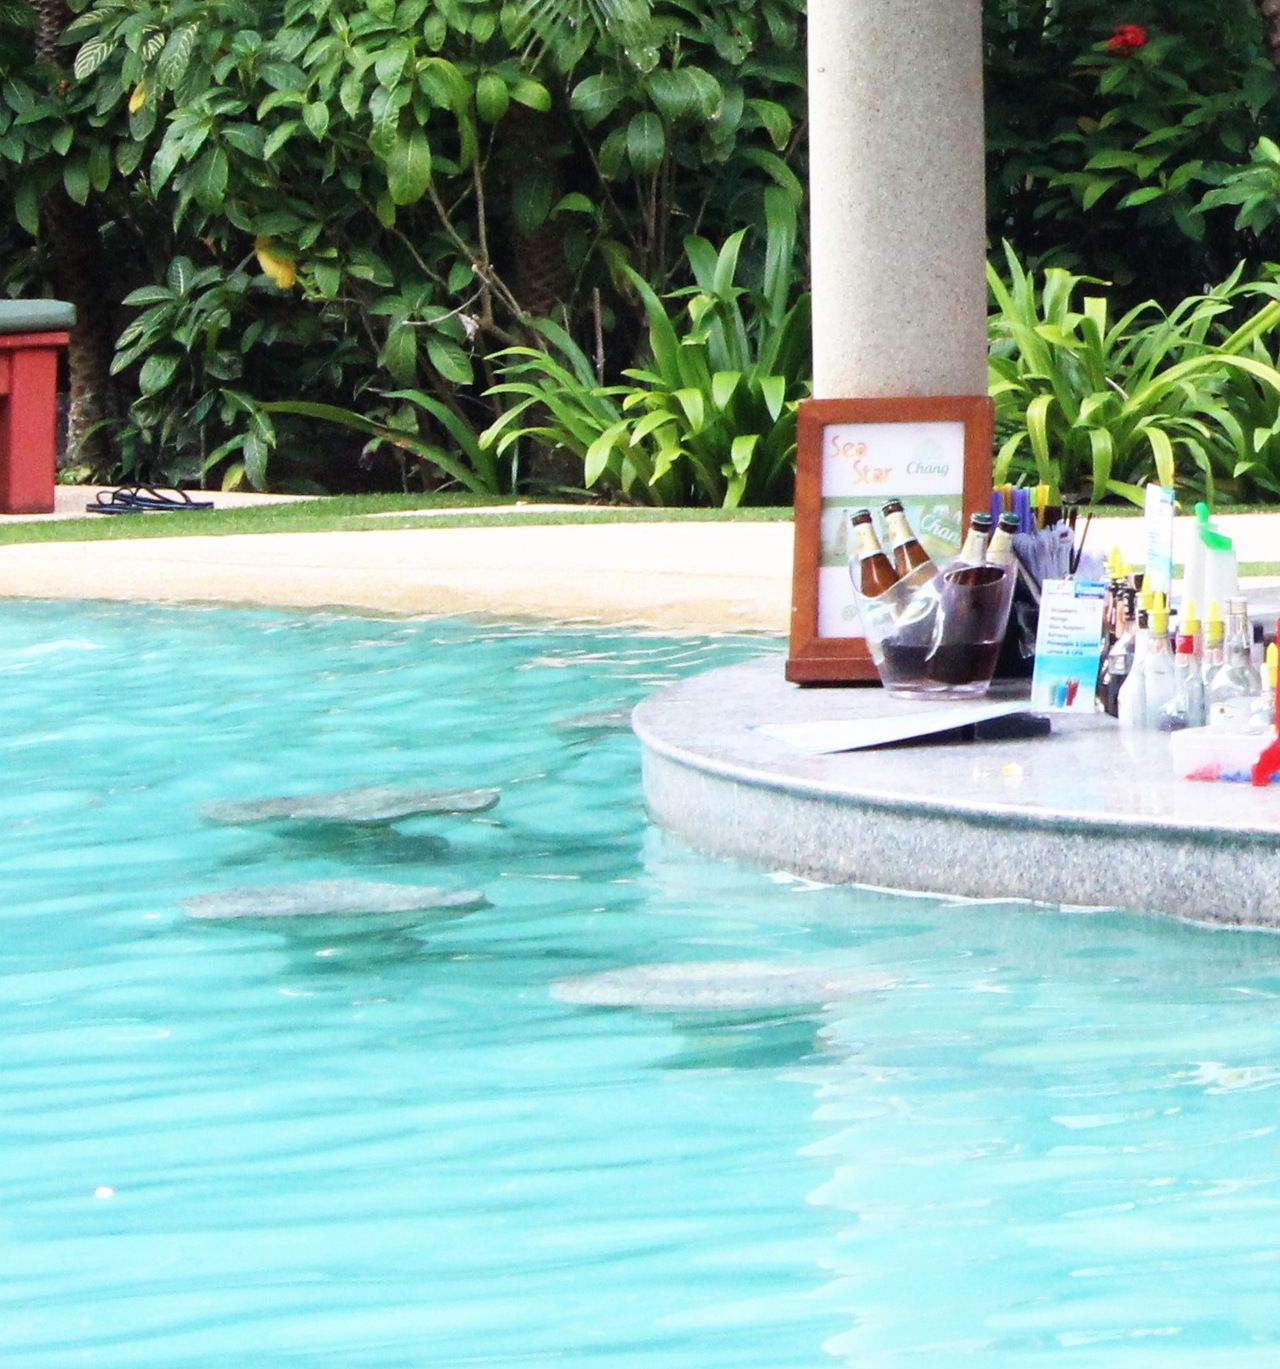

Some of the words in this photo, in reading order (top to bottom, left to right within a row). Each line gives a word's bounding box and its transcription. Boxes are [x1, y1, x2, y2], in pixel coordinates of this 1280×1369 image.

[830, 435, 868, 459] Sea
[853, 460, 894, 484] Star
[906, 461, 950, 478] Chang
